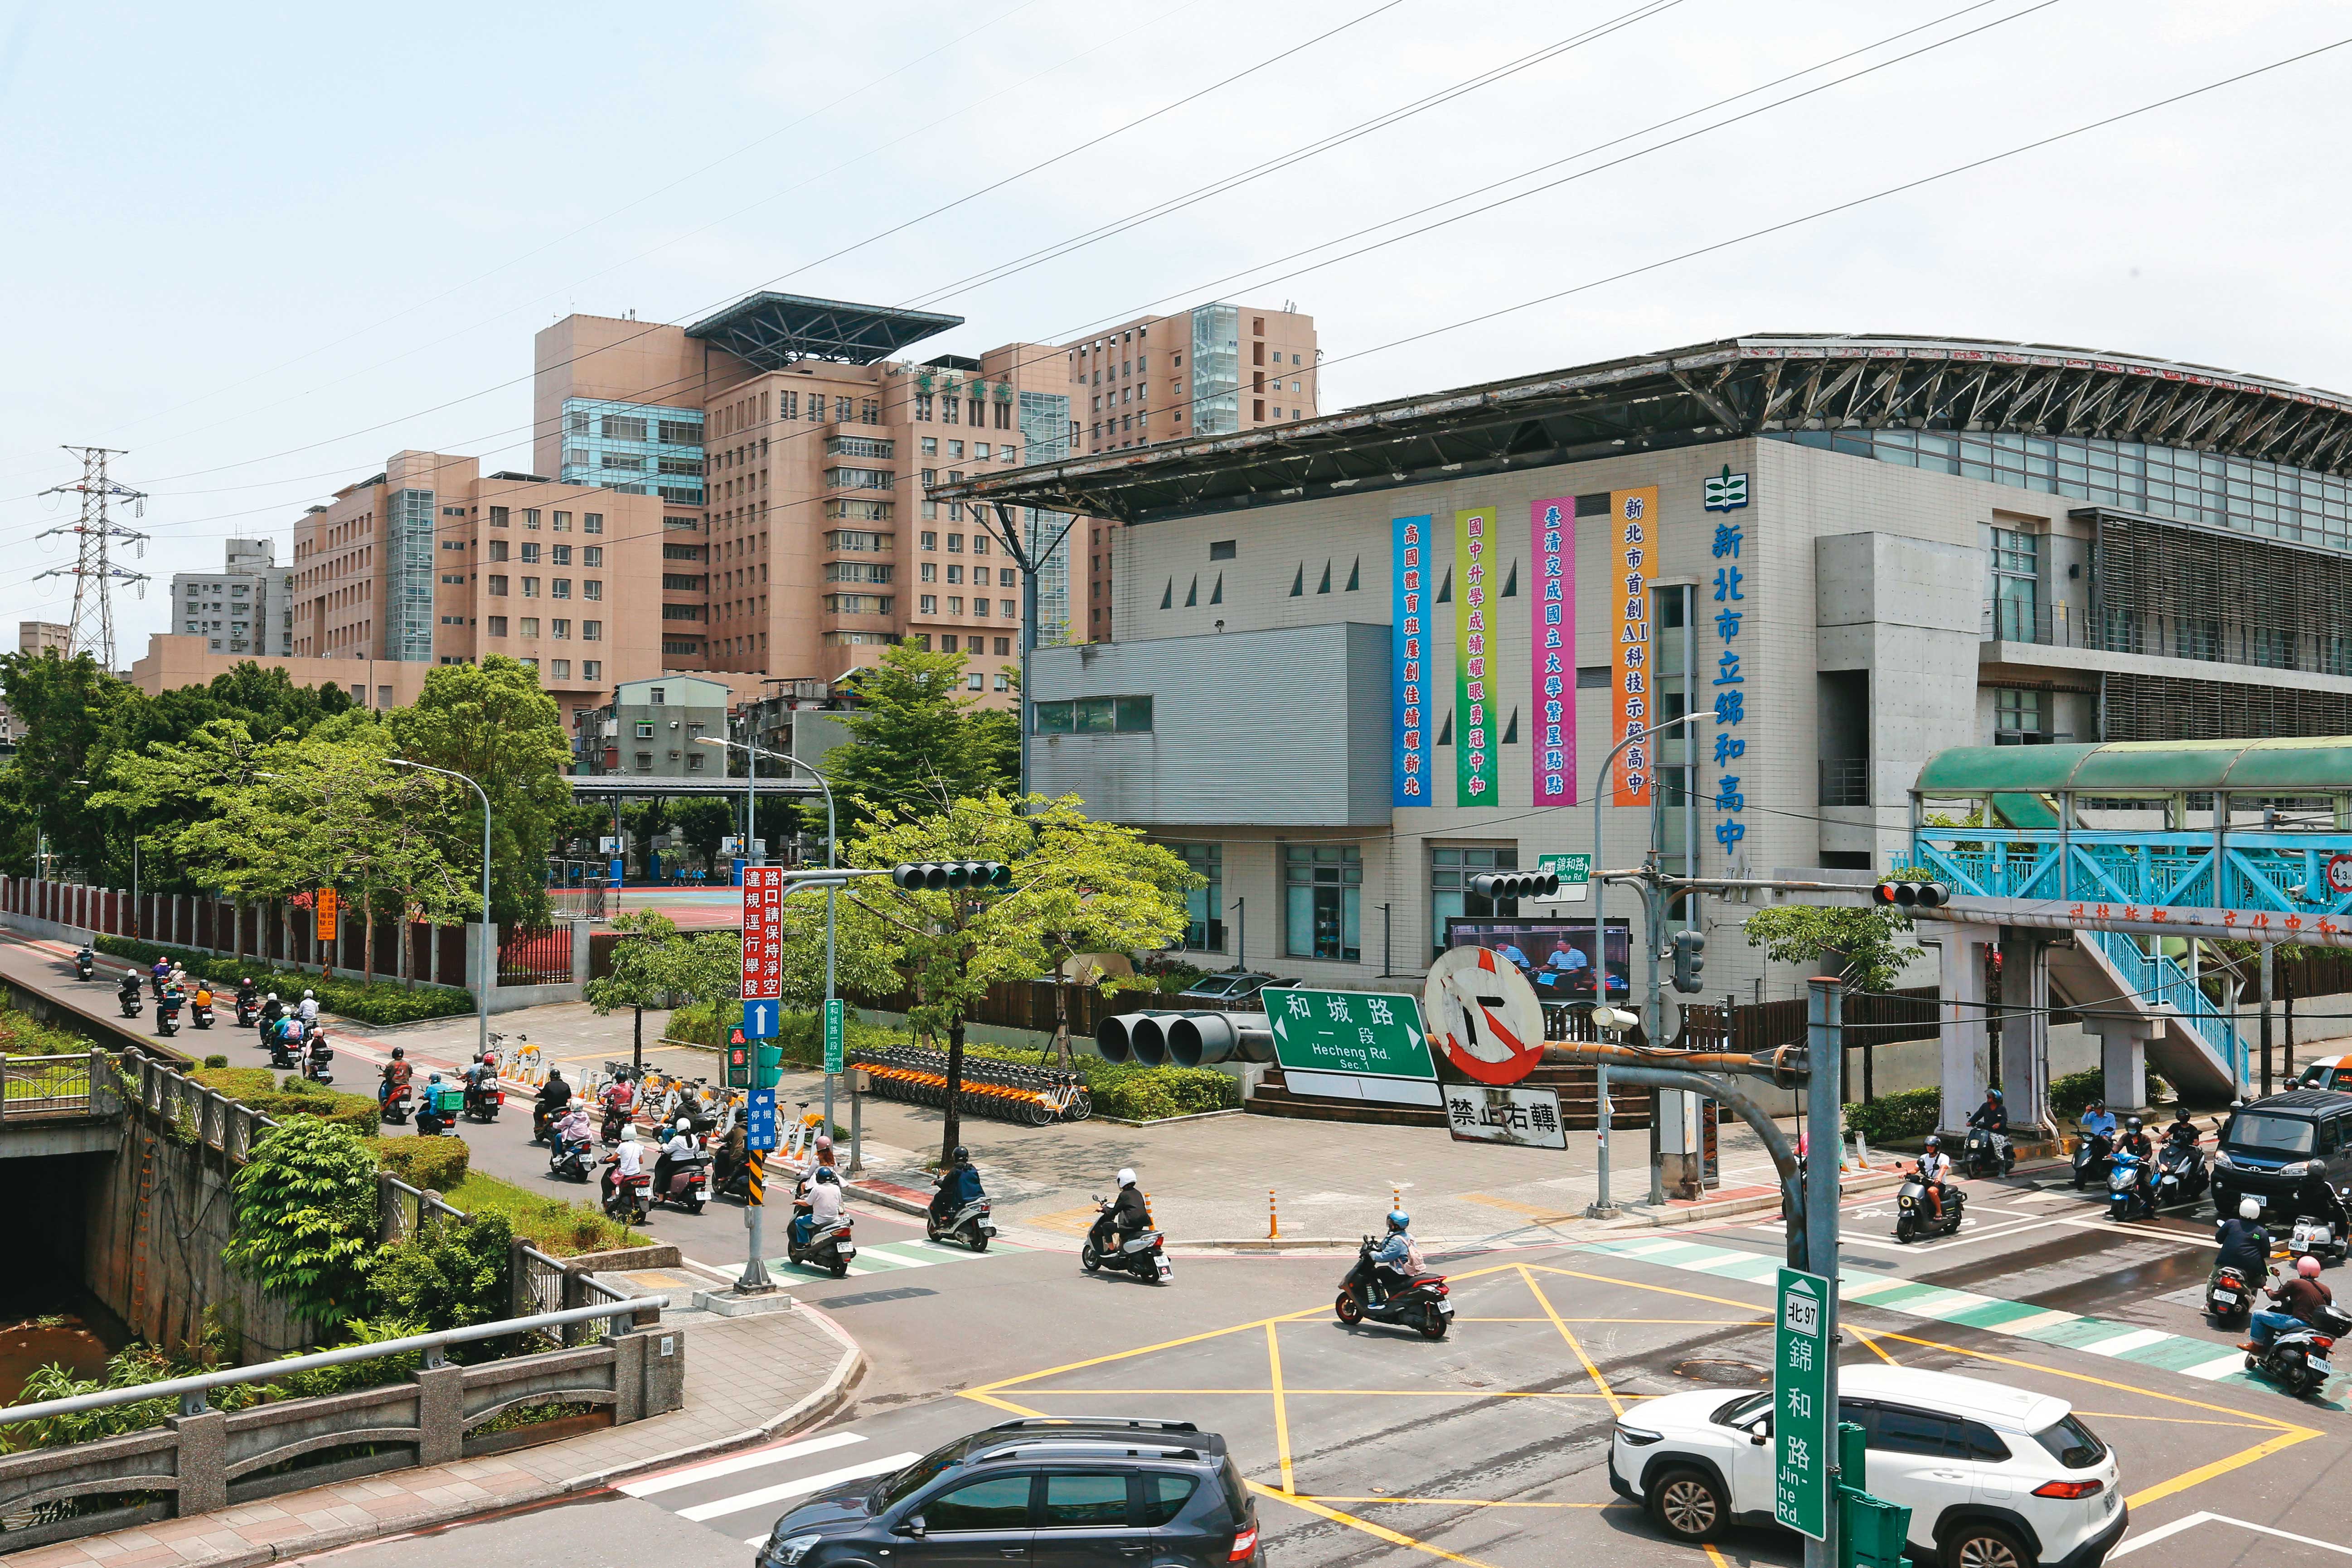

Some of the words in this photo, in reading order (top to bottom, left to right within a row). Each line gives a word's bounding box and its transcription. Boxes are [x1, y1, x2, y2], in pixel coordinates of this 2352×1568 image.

[1403, 524, 1421, 796] 高國體育班屢創佳績耀新北
[1467, 516, 1486, 797] 國中升學成績耀眼勇冠中和
[1544, 505, 1565, 795] 臺清交成國立大學繁星點點
[1712, 523, 1745, 855] 新北市立錦和高中
[1556, 857, 1585, 872] 錦和路
[745, 870, 761, 996] 違規逕行舉發
[763, 871, 780, 995] 路口請保持淨空
[1285, 993, 1394, 1026] 和城路
[830, 1007, 838, 1050] 和城路一段
[1318, 1026, 1376, 1045] 一段
[1312, 1042, 1366, 1060] Hecheng
[1369, 1046, 1391, 1060] Rd.
[1340, 1059, 1361, 1070] Sec.
[1364, 1060, 1370, 1070] 1
[750, 1110, 760, 1147] 停車場
[763, 1109, 772, 1146] 機車
[1450, 1098, 1557, 1133] 禁止右轉
[1787, 1336, 1813, 1471] 錦和路
[1778, 1465, 1809, 1486] Jin-
[1778, 1483, 1796, 1502] he
[1778, 1501, 1801, 1526] Rd.
